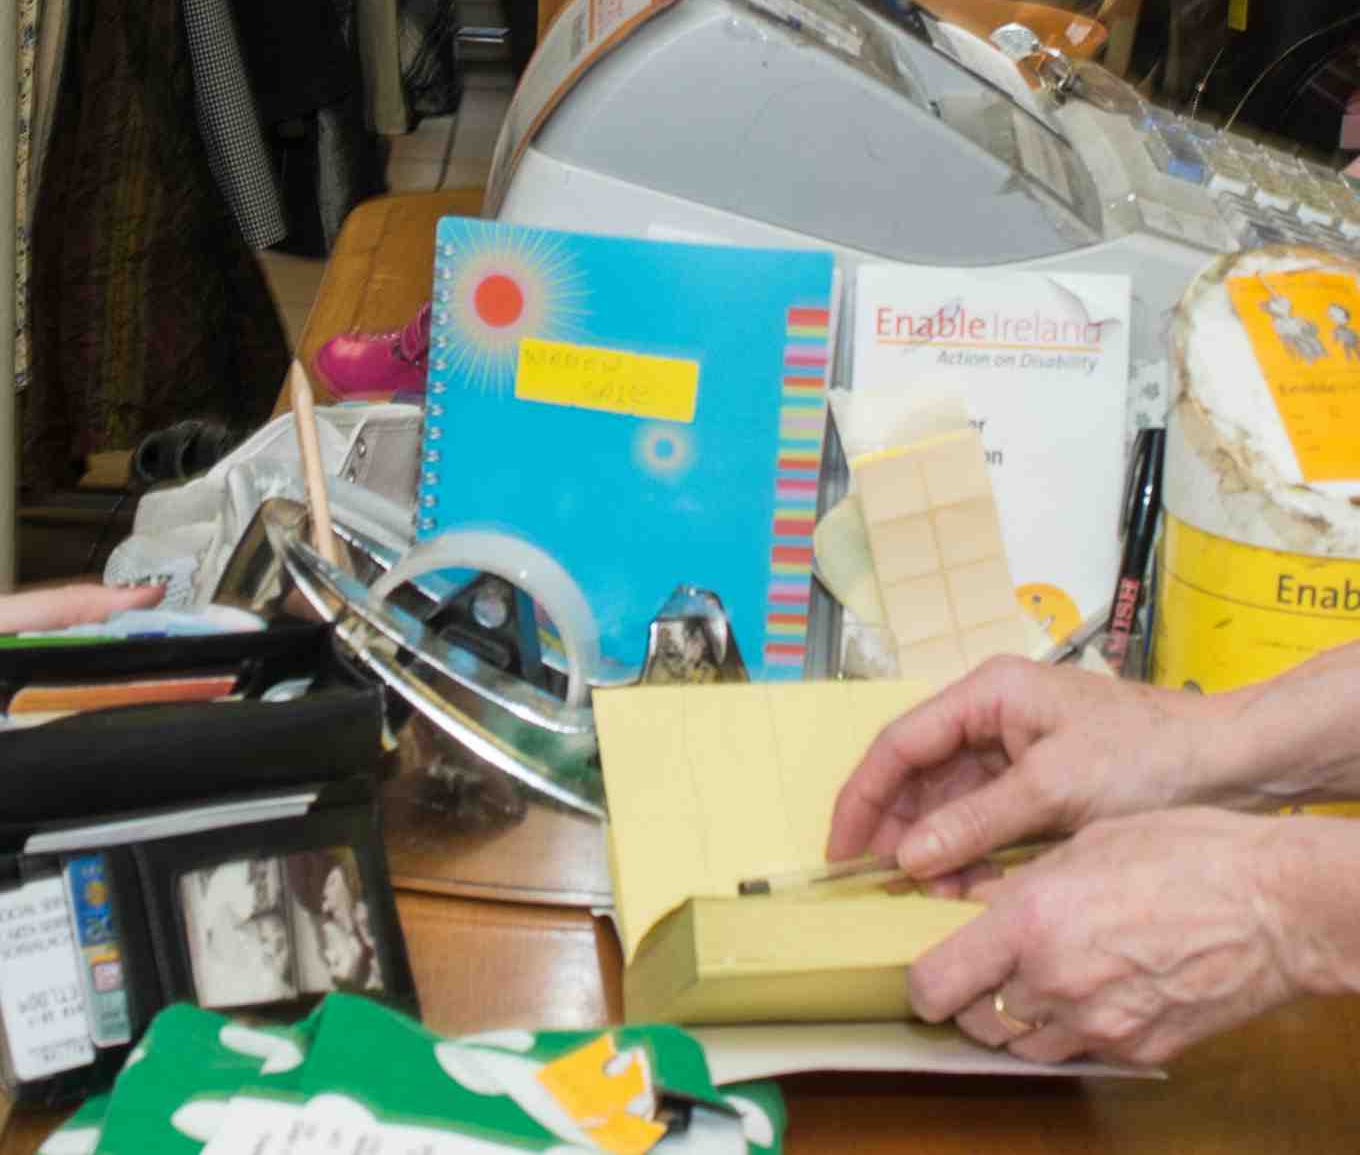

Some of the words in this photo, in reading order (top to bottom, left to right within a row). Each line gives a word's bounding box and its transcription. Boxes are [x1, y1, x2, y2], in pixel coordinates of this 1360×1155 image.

[875, 306, 986, 339] Enable
[993, 312, 1104, 344] Ireland
[936, 349, 990, 368] Action
[994, 355, 1016, 369] on
[1019, 352, 1099, 375] Disability
